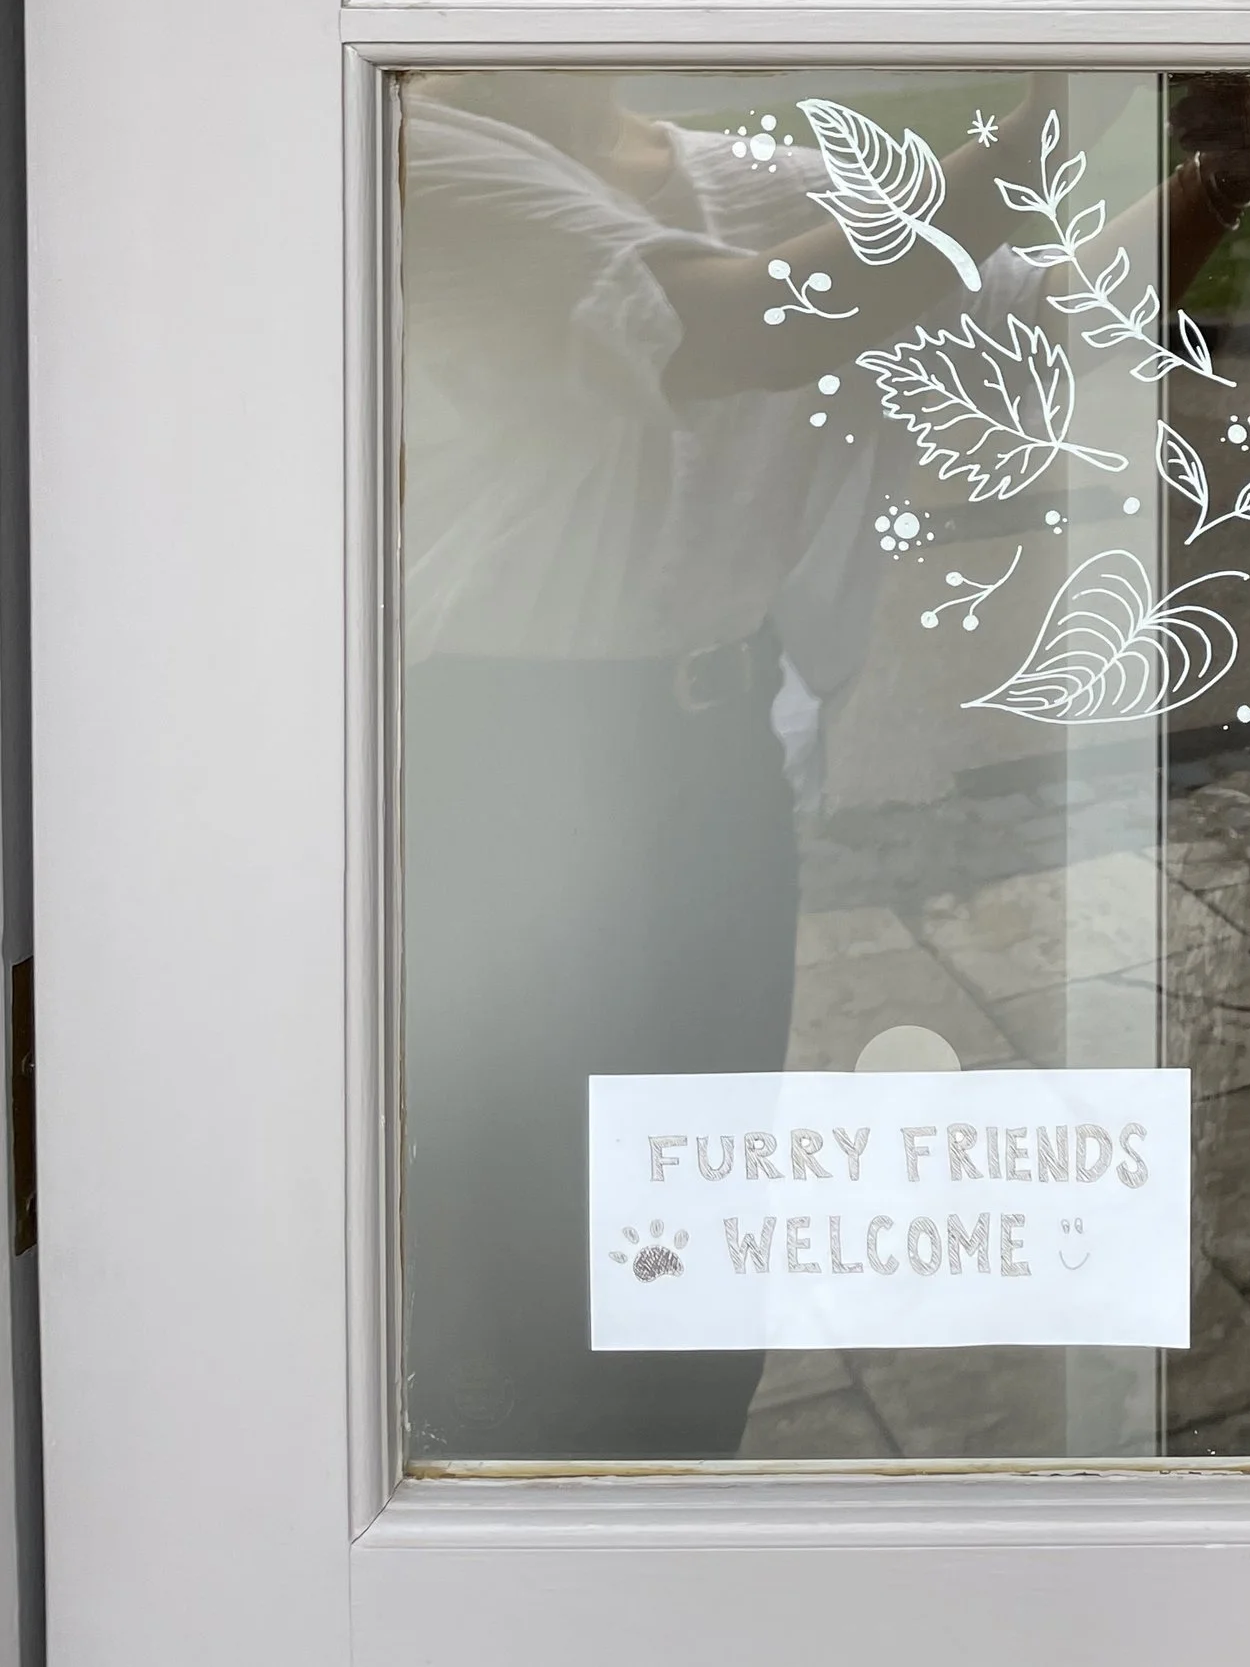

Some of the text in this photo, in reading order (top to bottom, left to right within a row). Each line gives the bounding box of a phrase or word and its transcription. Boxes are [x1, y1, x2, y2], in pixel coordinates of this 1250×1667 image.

[647, 1123, 1150, 1189] FURRY FRIENDS
[722, 1212, 1033, 1277] WELCOME
